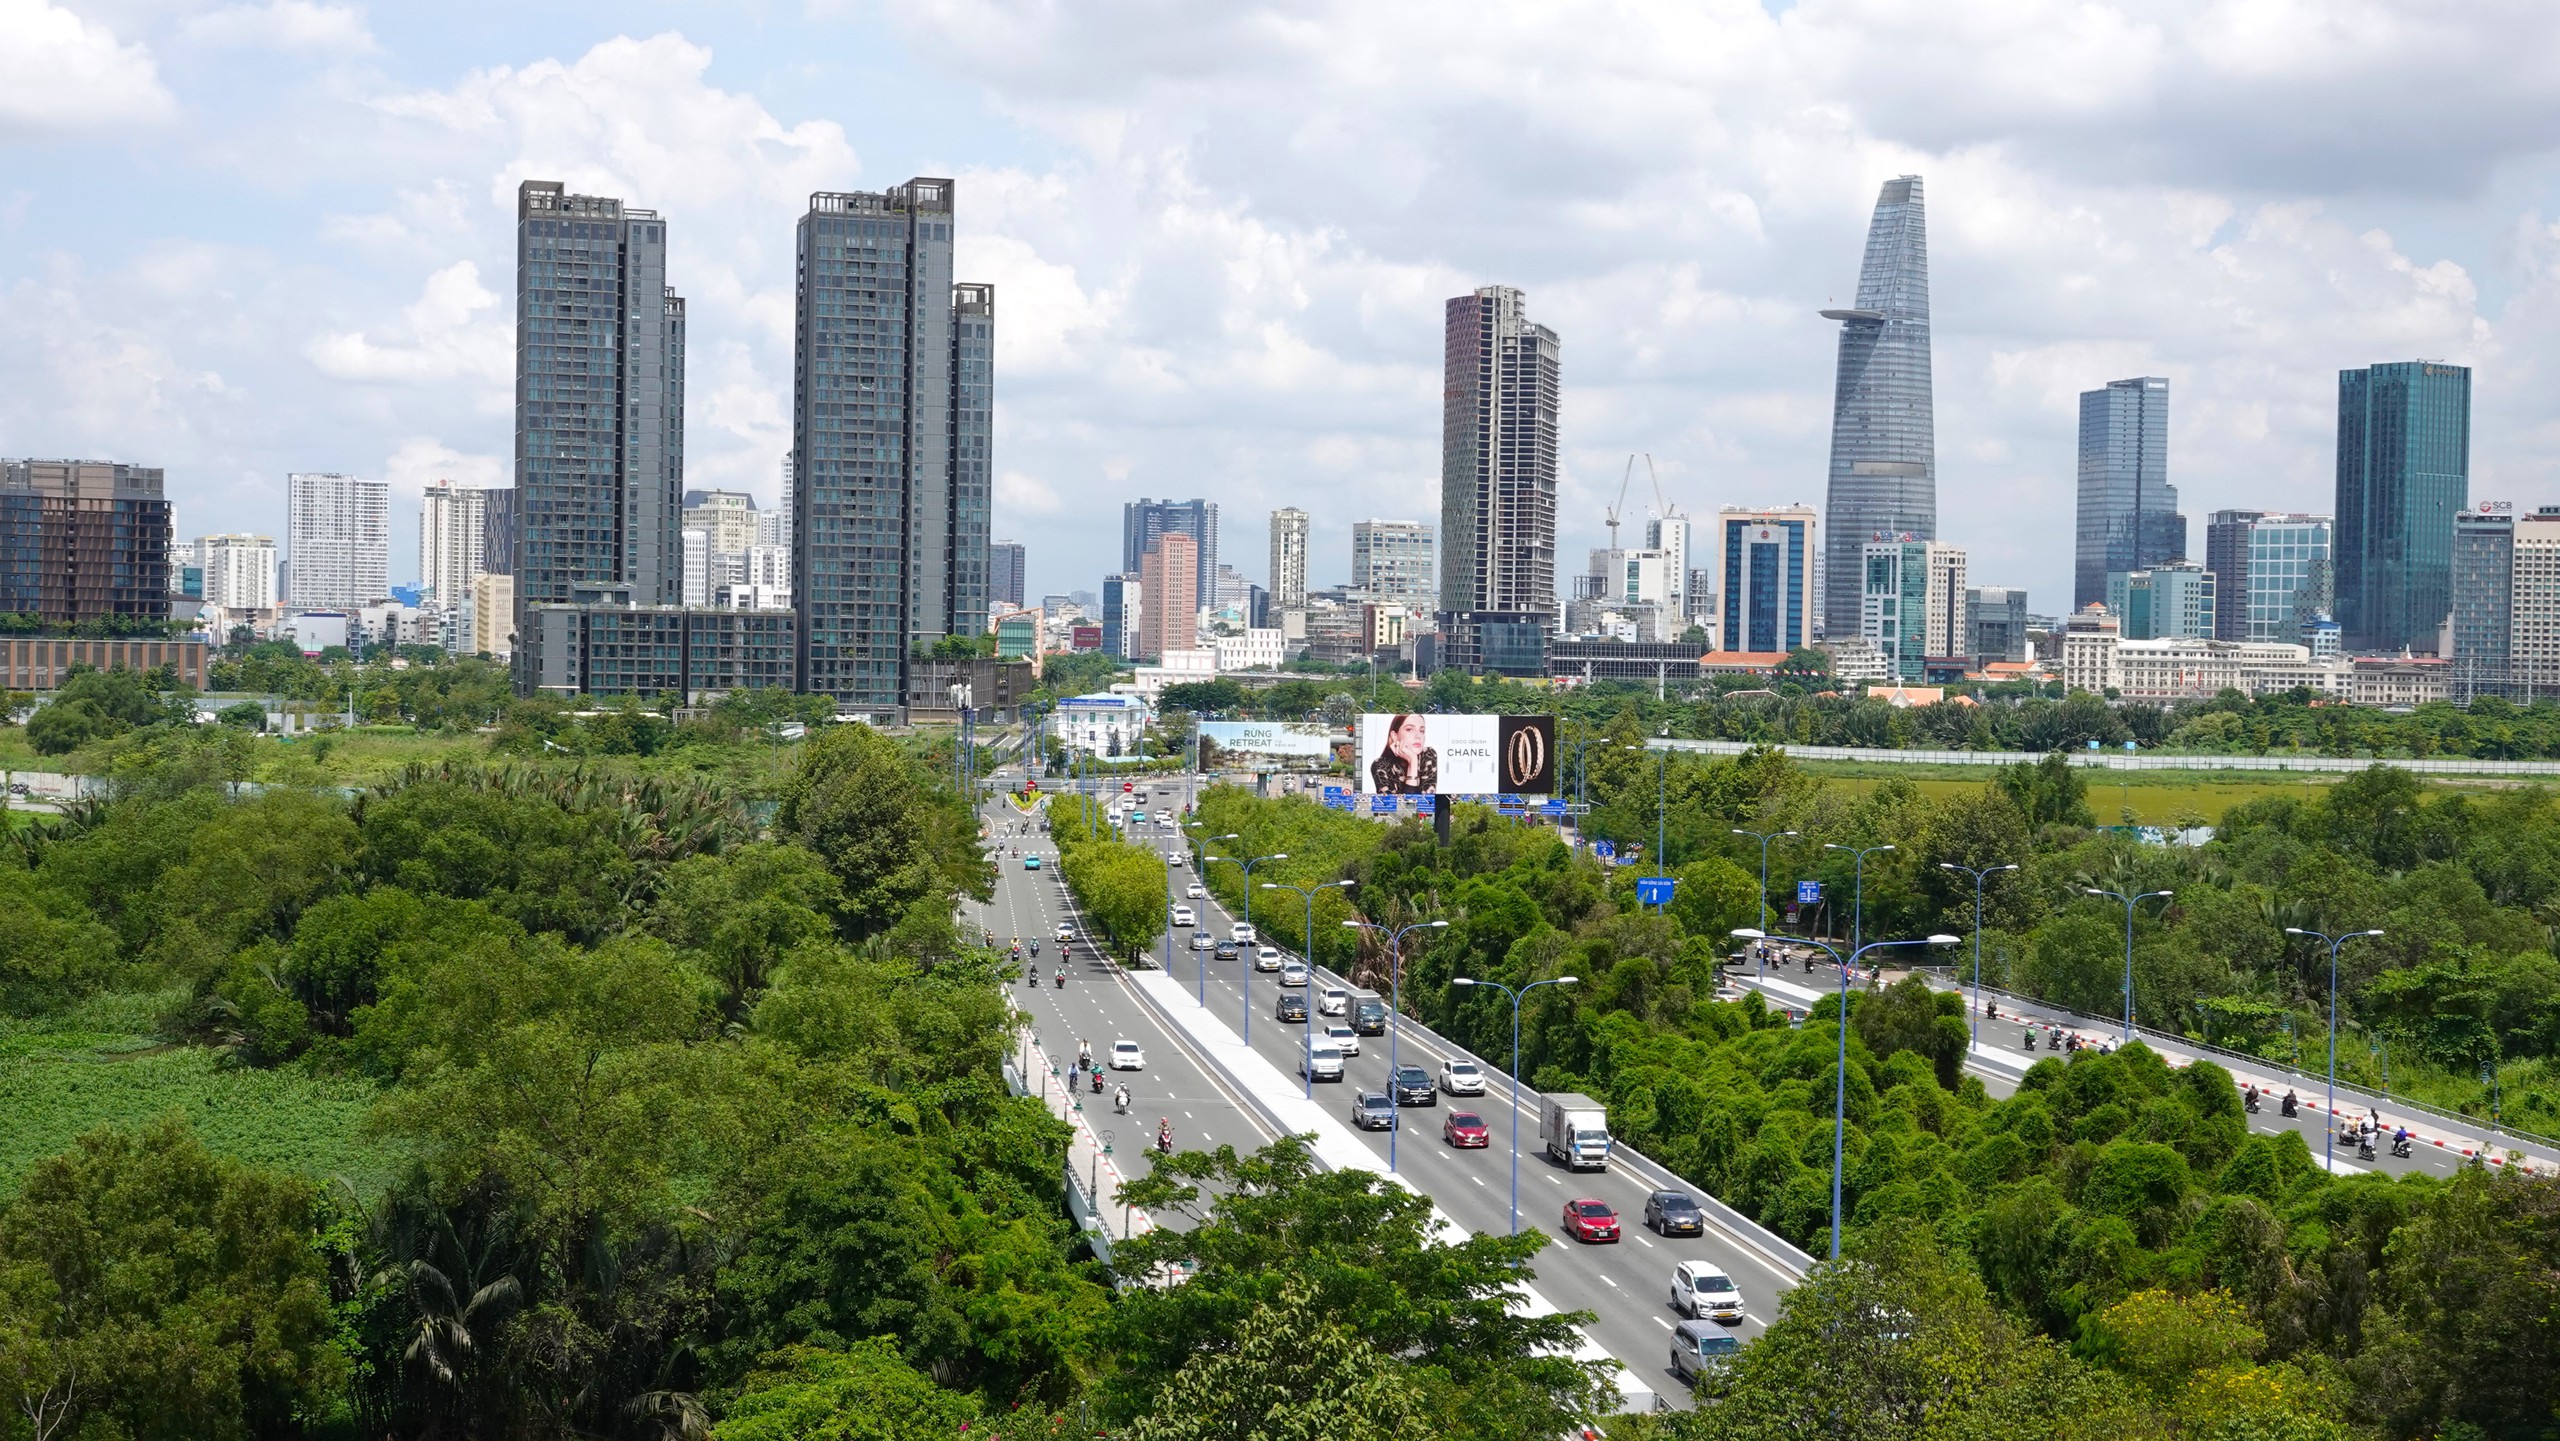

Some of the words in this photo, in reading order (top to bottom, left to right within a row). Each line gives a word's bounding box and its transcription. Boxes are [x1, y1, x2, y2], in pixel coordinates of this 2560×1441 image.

[2492, 501, 2513, 510] SCB
[1243, 727, 1272, 738] RỪNG
[1229, 738, 1272, 747] RETREAT
[1447, 748, 1491, 757] CHANEL
